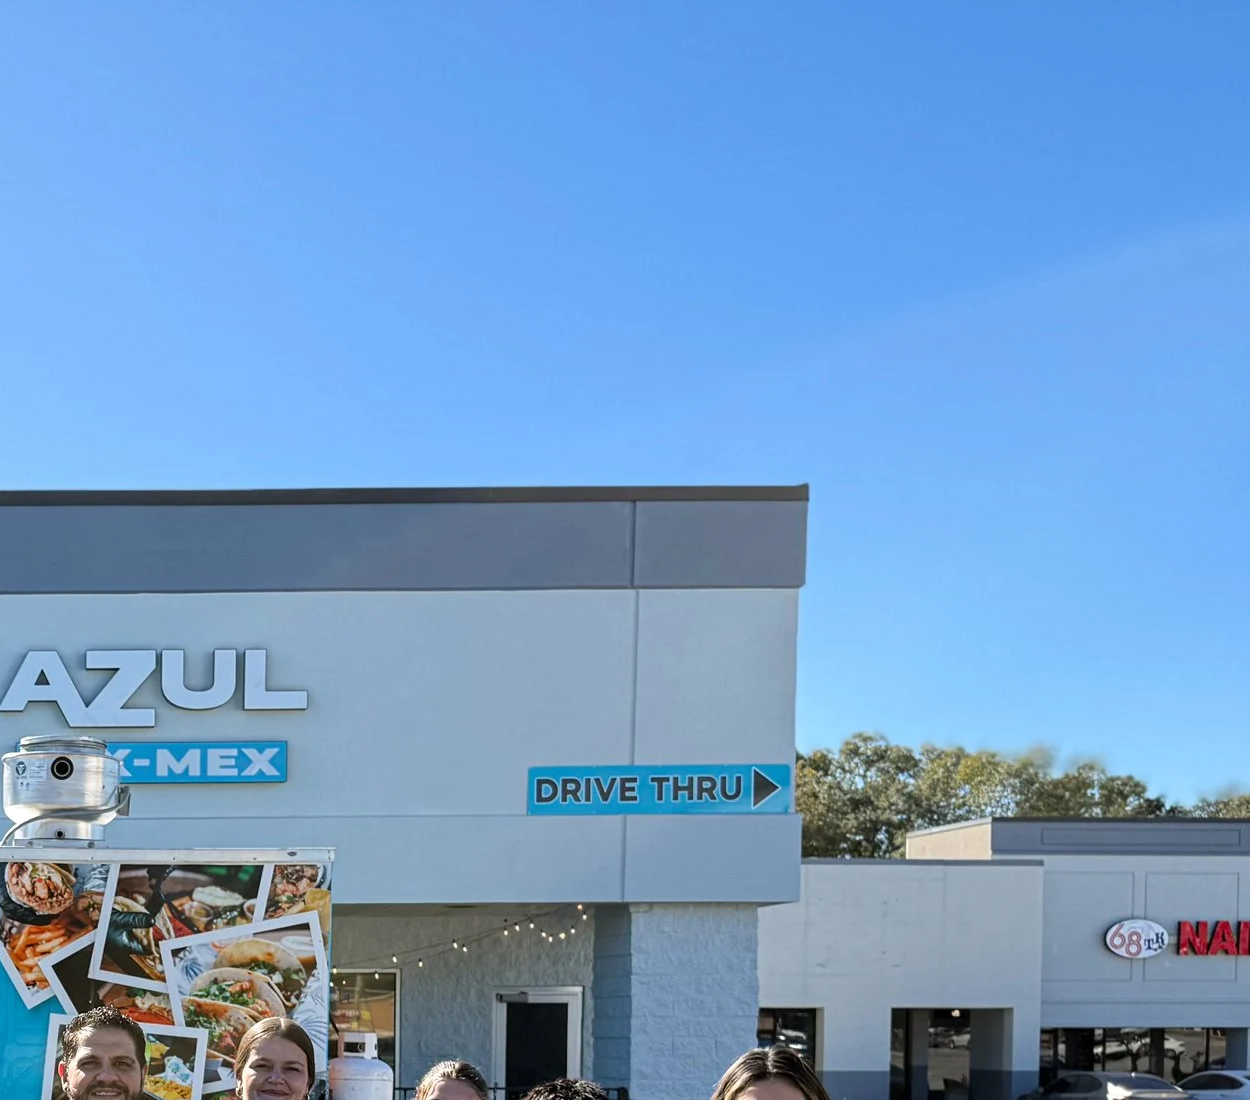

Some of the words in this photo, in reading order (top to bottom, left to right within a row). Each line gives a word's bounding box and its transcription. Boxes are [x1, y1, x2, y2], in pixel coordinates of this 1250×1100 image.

[535, 777, 639, 803] DRIVE
[651, 775, 742, 801] THRU
[1109, 922, 1142, 957] 68
